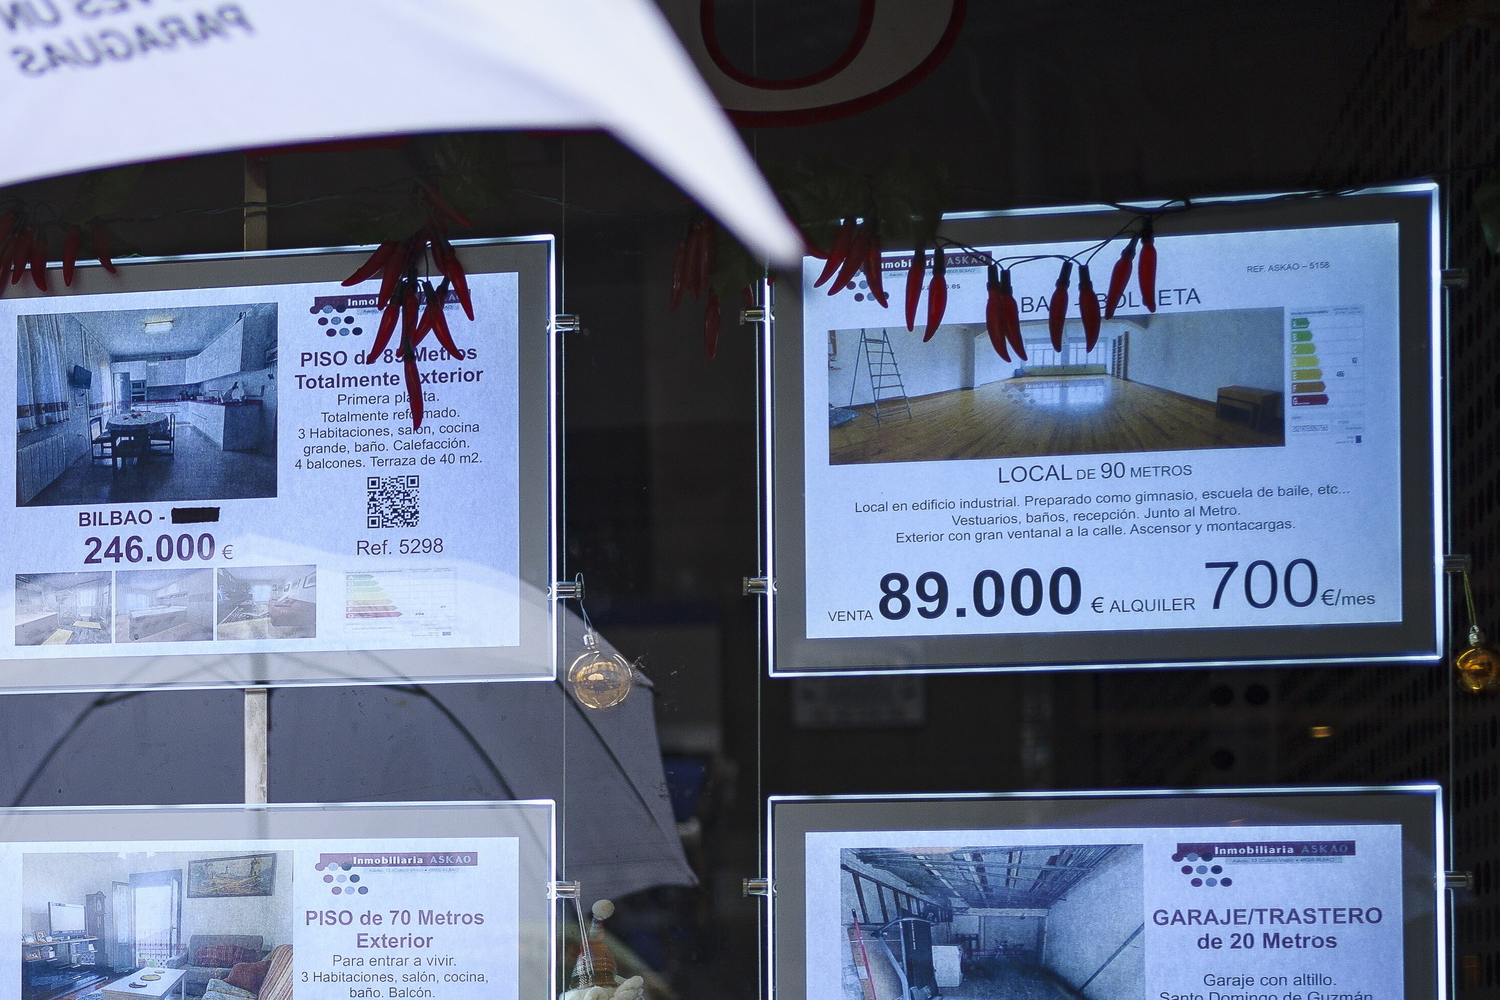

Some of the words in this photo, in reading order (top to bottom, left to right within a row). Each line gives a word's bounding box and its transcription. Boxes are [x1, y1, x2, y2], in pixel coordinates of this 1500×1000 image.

[1246, 264, 1265, 273] REF.
[1267, 262, 1300, 272] ASKAO
[1308, 260, 1331, 270] 5158
[294, 371, 400, 390] Totalmente
[420, 366, 485, 385] xterior
[294, 458, 302, 470] 4
[306, 457, 366, 470] balcones.
[369, 455, 416, 467] Terraza
[419, 453, 436, 466] de
[439, 452, 456, 465] 40
[459, 451, 483, 464] m2.
[998, 463, 1073, 484] LOCAL
[1076, 468, 1096, 480] DE
[1100, 461, 1126, 479] 90
[1129, 464, 1193, 478] METROS
[854, 500, 888, 513] Local
[891, 502, 908, 512] en
[911, 498, 956, 511] edificio
[959, 496, 1020, 509] industrial.
[1024, 493, 1092, 508] Preparado
[1095, 493, 1132, 504] como
[1134, 489, 1198, 505] gimnasio,
[1201, 486, 1253, 500] escuela
[1256, 485, 1274, 498] de
[1276, 484, 1313, 498] baile,
[78, 508, 153, 527] BILBAO
[83, 532, 215, 565] 246.000
[221, 544, 233, 560] €
[356, 538, 392, 556] Ref.
[398, 536, 444, 555] 5298
[1204, 557, 1319, 610] 700
[878, 566, 1082, 621] 89.000
[1320, 588, 1376, 606] €/mes
[1090, 596, 1105, 614] €
[1108, 597, 1196, 613] ALQUILER
[827, 609, 874, 622] VENTA
[352, 855, 424, 865] Inmobiliaria
[429, 854, 472, 864] ASKAO
[305, 909, 353, 926] PISO
[359, 909, 383, 926] de
[388, 909, 411, 926] 70
[417, 909, 485, 926] Metros
[1152, 906, 1383, 926] GARAJE/TRASTERO
[356, 932, 434, 949] Exterior
[1196, 932, 1223, 950] de
[1229, 932, 1255, 950] 20
[1262, 931, 1338, 949] Metros
[332, 954, 364, 967] Para
[368, 954, 410, 967] entrar
[413, 956, 422, 967] a
[425, 954, 457, 967] vivir.
[349, 986, 384, 999] baño.
[388, 986, 435, 998] Balcón.
